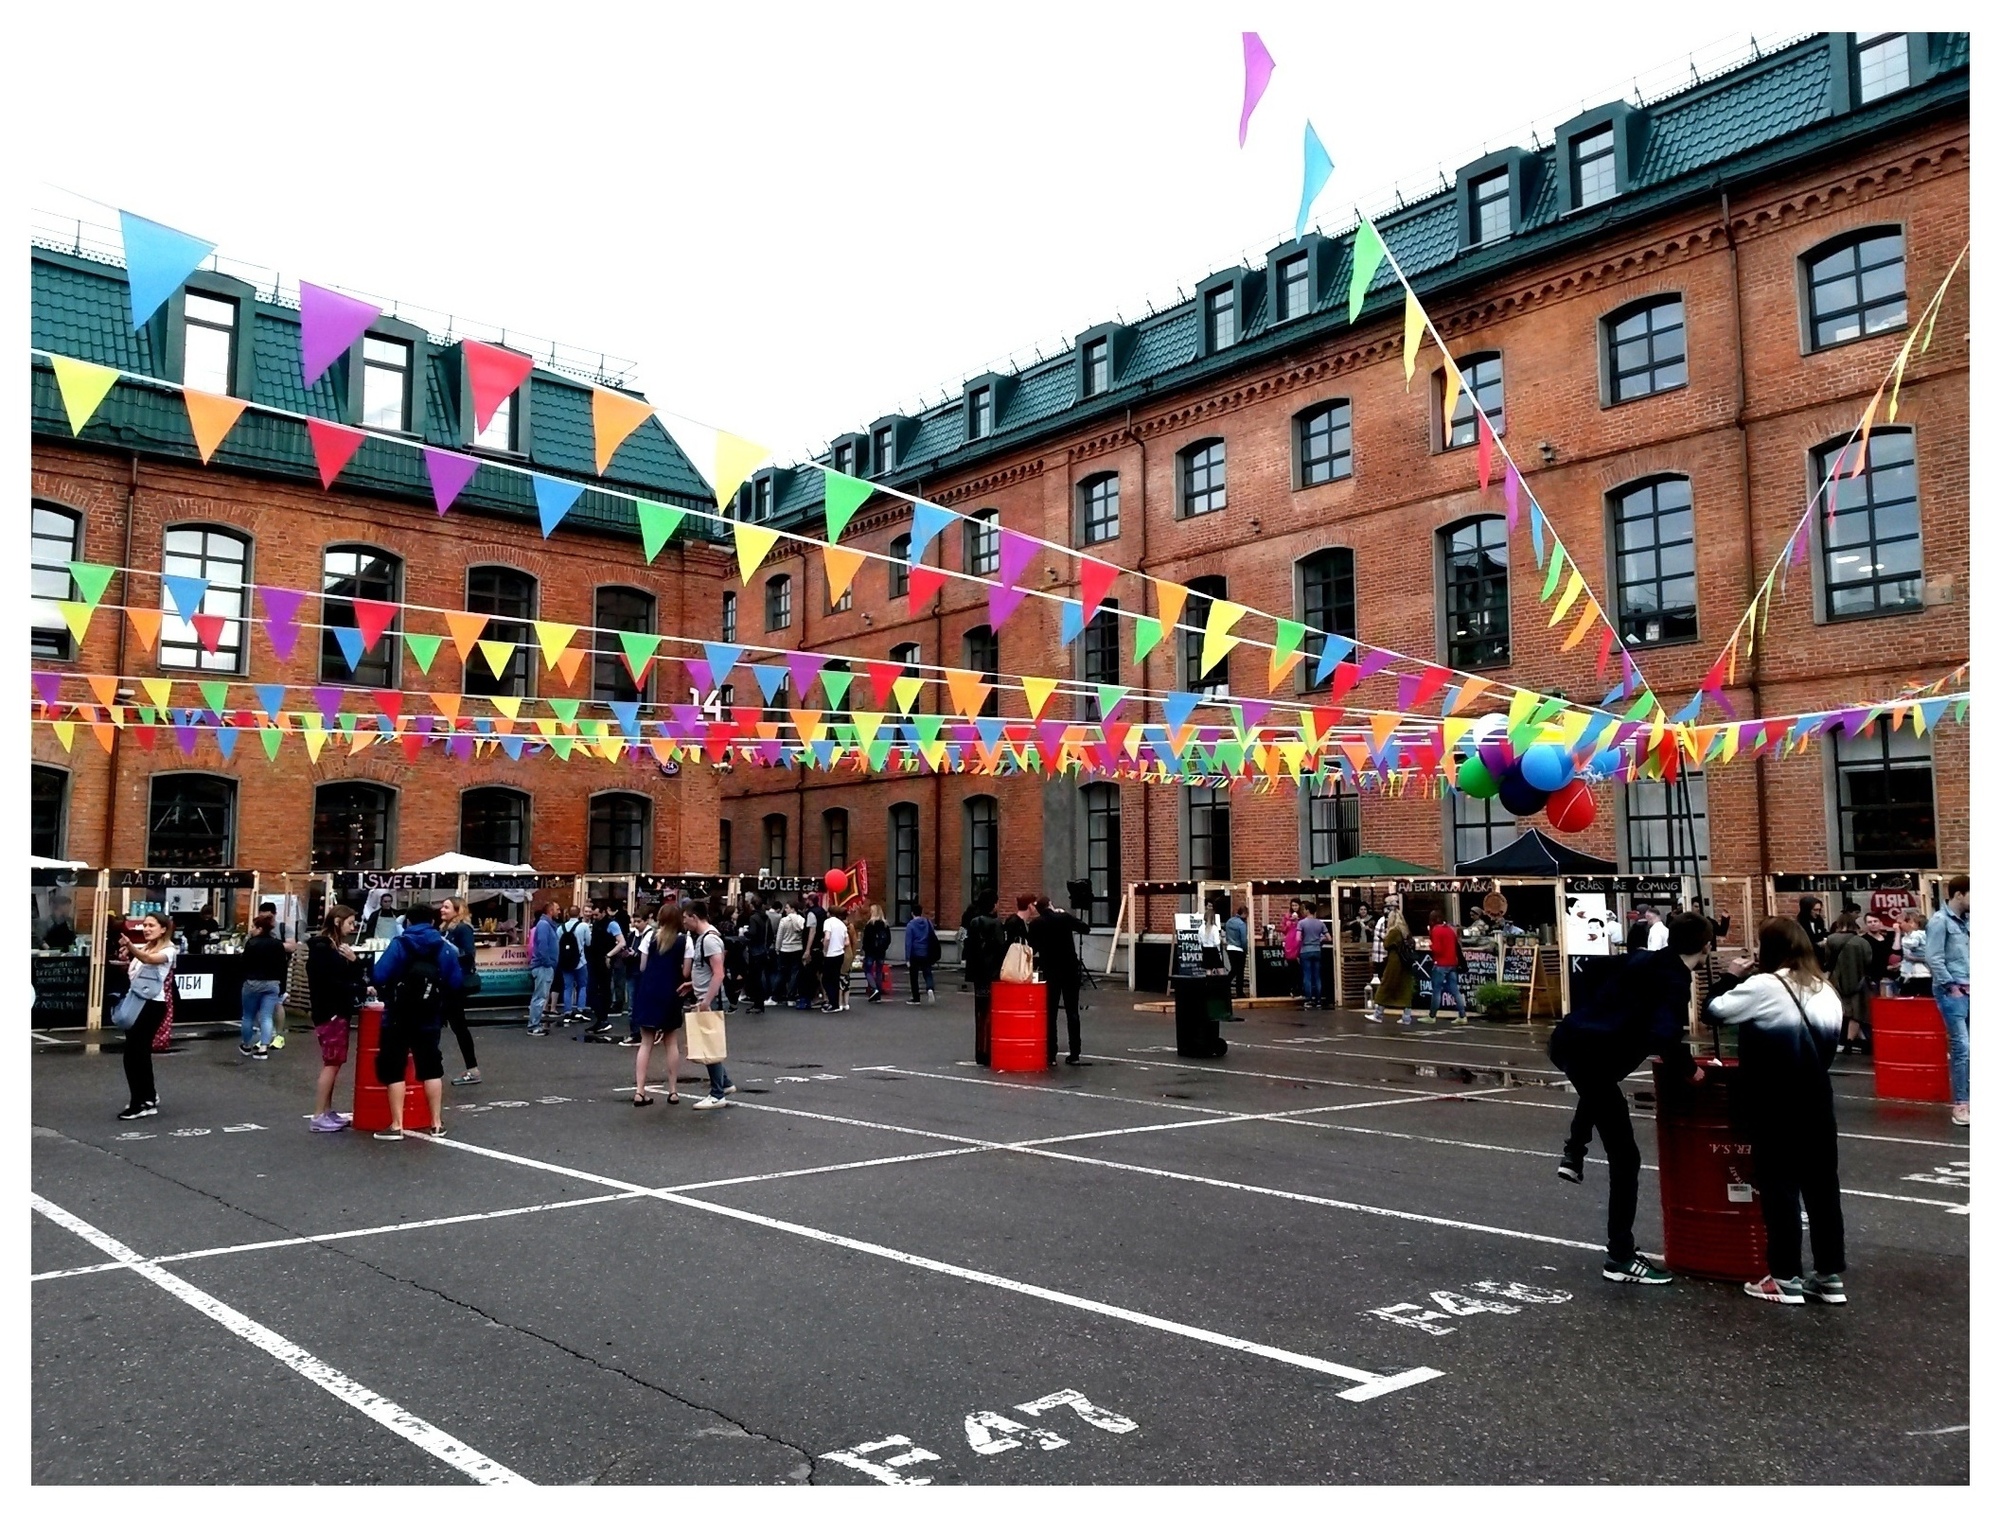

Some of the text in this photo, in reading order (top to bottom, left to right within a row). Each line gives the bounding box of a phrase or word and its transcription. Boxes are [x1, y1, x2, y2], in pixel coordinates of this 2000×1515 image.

[689, 687, 721, 722] 14
[121, 873, 192, 886] ДАБЛБИ
[757, 879, 777, 891] LAO
[779, 879, 801, 891] LEE
[1574, 880, 1680, 892] CRABS ARE COMING
[1461, 880, 1494, 893] ЛАВКА
[1875, 894, 1910, 907] ПЯН
[177, 976, 202, 990] ЛБИ
